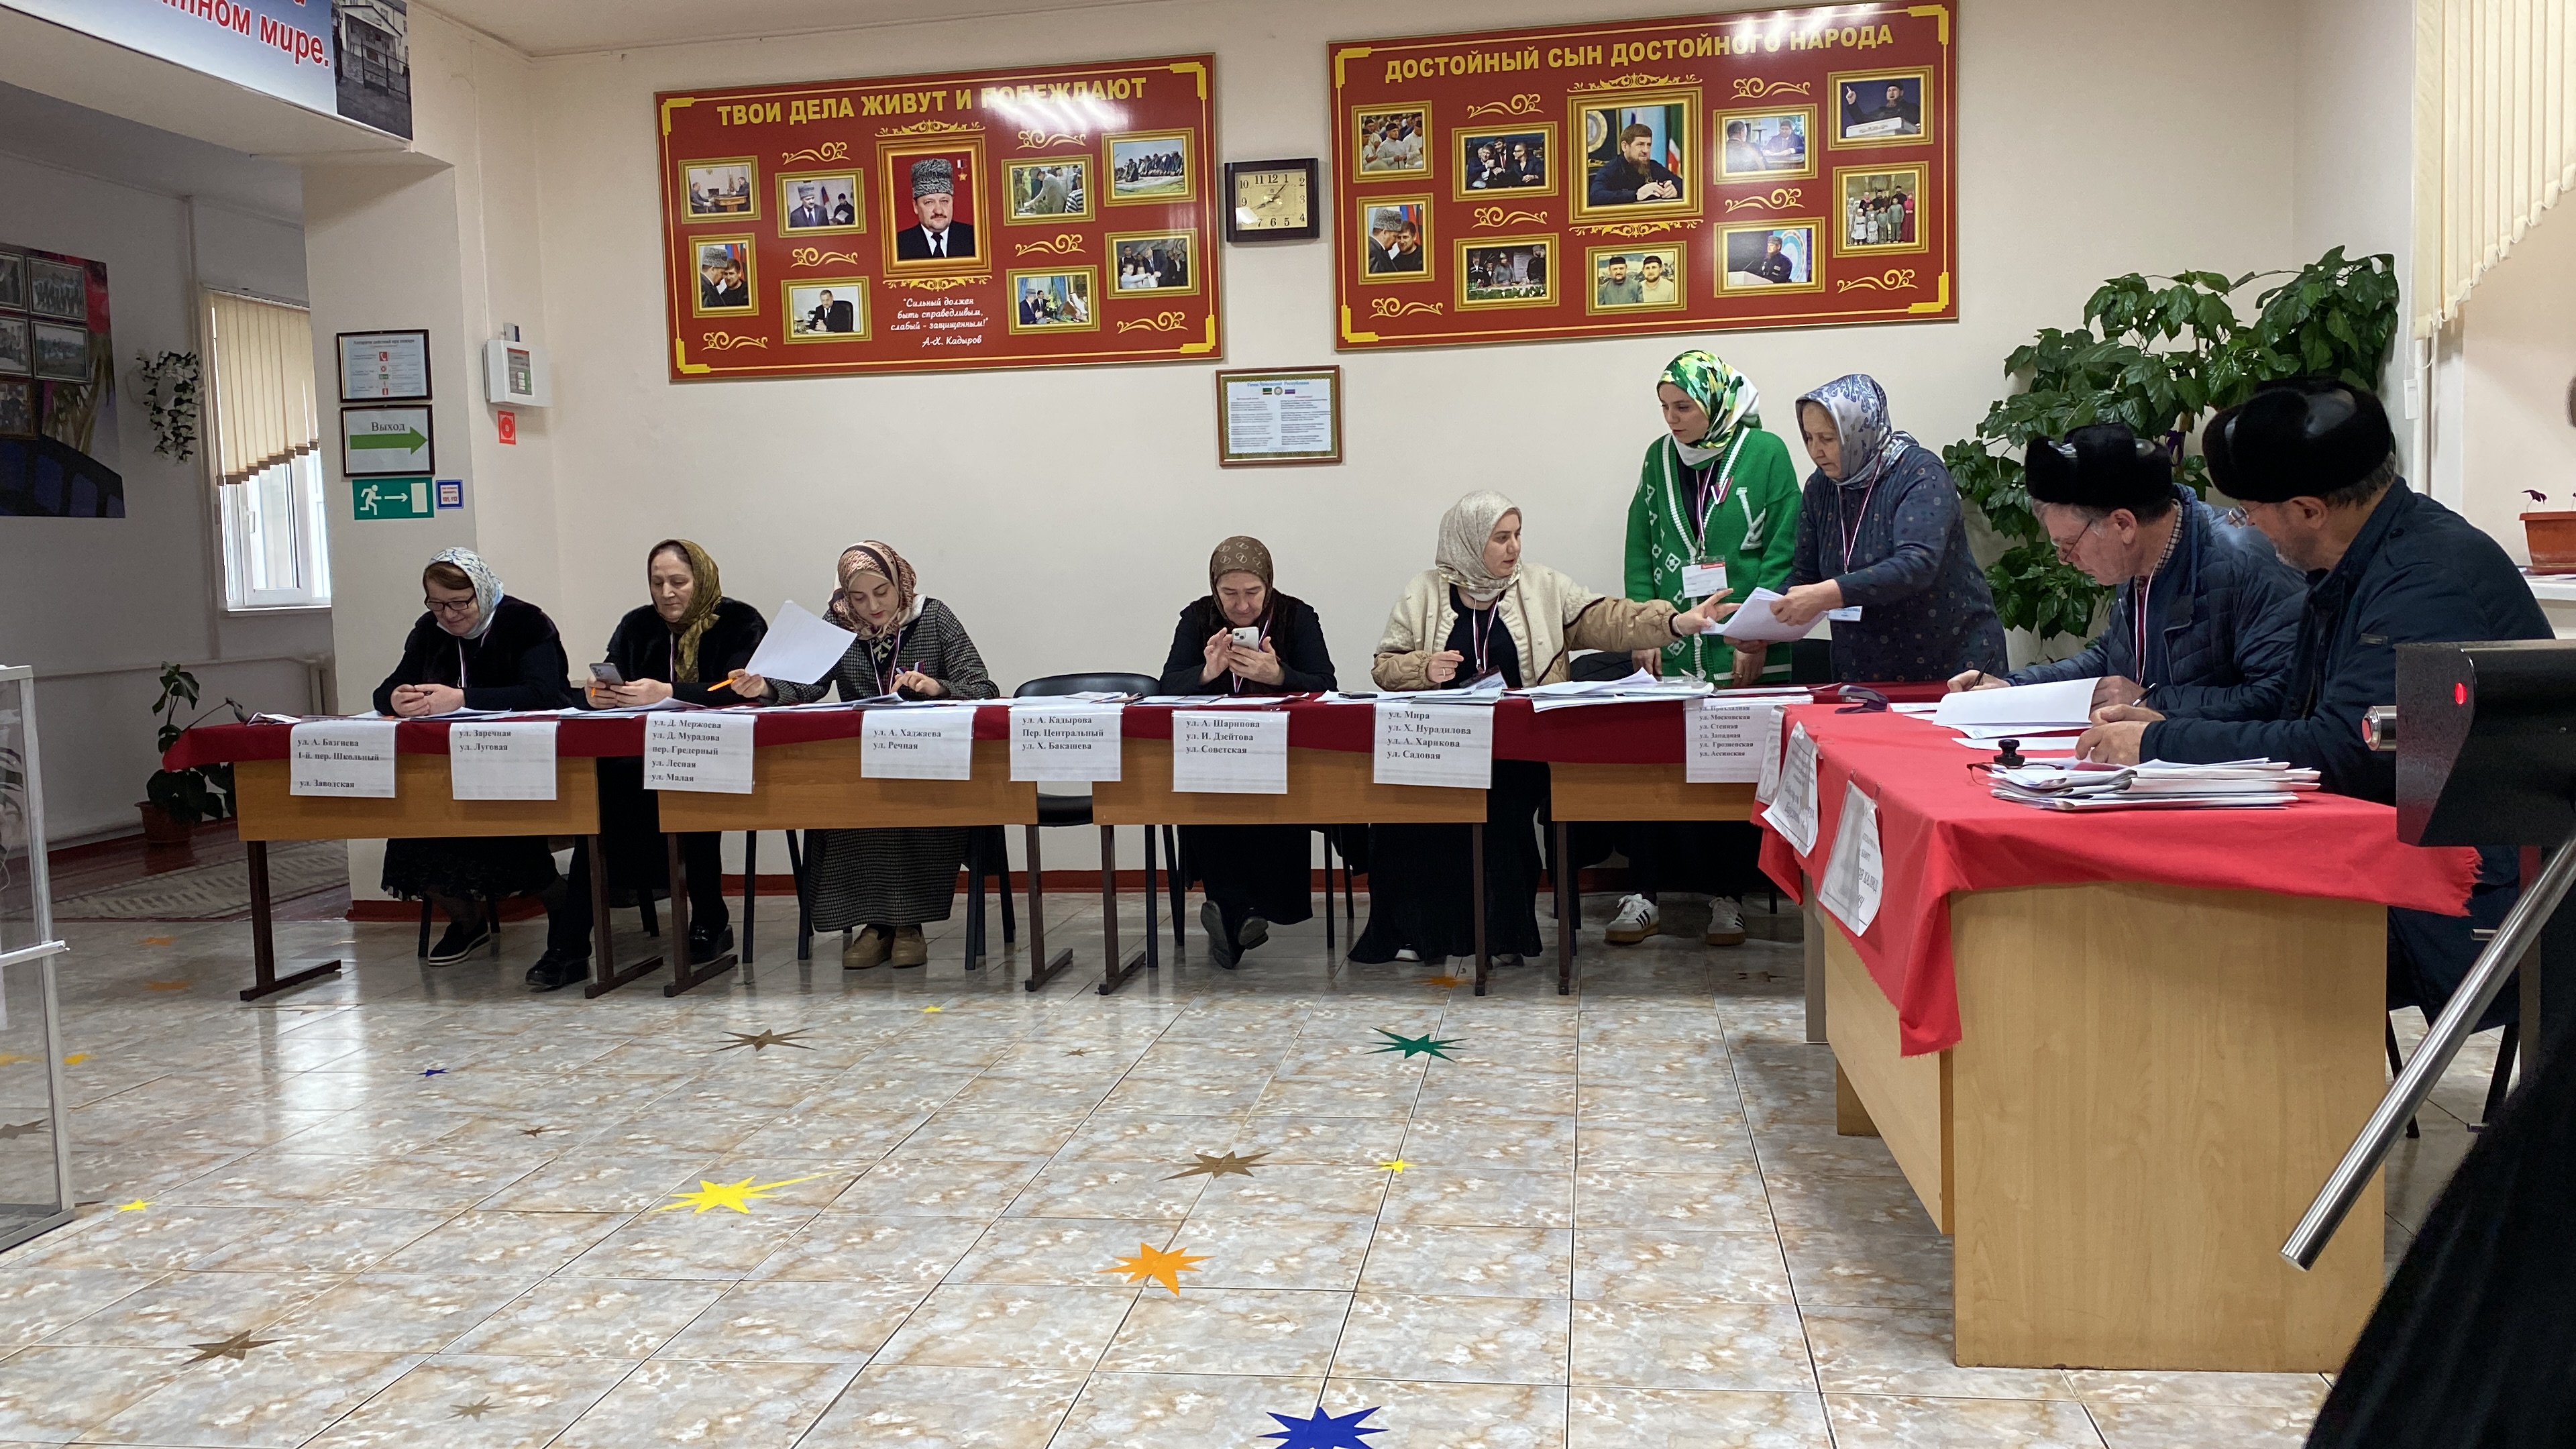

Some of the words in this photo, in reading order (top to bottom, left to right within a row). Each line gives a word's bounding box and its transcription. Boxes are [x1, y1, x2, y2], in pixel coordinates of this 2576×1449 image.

[260, 15, 329, 67] мире.
[1385, 46, 1539, 84] ДОСТОЙНЫЙ
[1548, 45, 1603, 68] СЫН
[1611, 32, 1780, 67] ДОСТОЙНОГО
[1790, 24, 1893, 51] НАРОДА
[716, 102, 781, 125] ТВОИ
[790, 97, 855, 125] ДЕЛА
[861, 91, 947, 116] ЖИВУТ
[956, 89, 972, 110] И
[981, 77, 1146, 109] ПОБЕЖДАЮТ
[1255, 175, 1264, 184] 11
[1268, 174, 1278, 184] 12
[1299, 177, 1305, 186] 2
[1240, 180, 1248, 189] 10
[1241, 197, 1247, 206] 9
[1299, 195, 1305, 203] 3
[1284, 217, 1289, 226] 5
[1299, 213, 1305, 222] 4
[1271, 218, 1277, 227] 6
[944, 297, 974, 306] должен
[897, 310, 919, 319] быть
[890, 321, 920, 331] слабый
[946, 335, 982, 346] Кадыров
[372, 422, 406, 431] Выход
[1049, 716, 1092, 725] Кадырова
[1405, 711, 1430, 721] Мира
[667, 719, 676, 727] Д.
[679, 720, 721, 729] Мержоева
[1213, 720, 1260, 729] Шарипова
[900, 729, 941, 737] Хаджаева
[1022, 729, 1041, 739] Пер.
[1044, 729, 1104, 739] Центральный
[1403, 724, 1413, 732] Х.
[1415, 724, 1471, 735] Нурадилова
[459, 731, 471, 739] ул.
[473, 730, 511, 738] Заречная
[667, 731, 676, 740] Д.
[678, 732, 720, 742] Мурадова
[1213, 733, 1253, 741] Дзейтова
[888, 741, 918, 750] Речная
[1049, 742, 1091, 750] Бакашева
[1387, 738, 1401, 746] ул.
[1415, 737, 1460, 748] Харикова
[474, 743, 508, 752] Луговая
[652, 746, 669, 754] пер.
[1201, 745, 1247, 753] Советская
[333, 752, 379, 761] Школьный
[1403, 750, 1440, 759] Садовая
[651, 760, 664, 768] ул.
[666, 759, 696, 768] Лесная
[651, 773, 664, 782] ул.
[666, 773, 694, 782] Малая
[300, 780, 311, 788] ул.
[313, 780, 355, 788] Заводская
